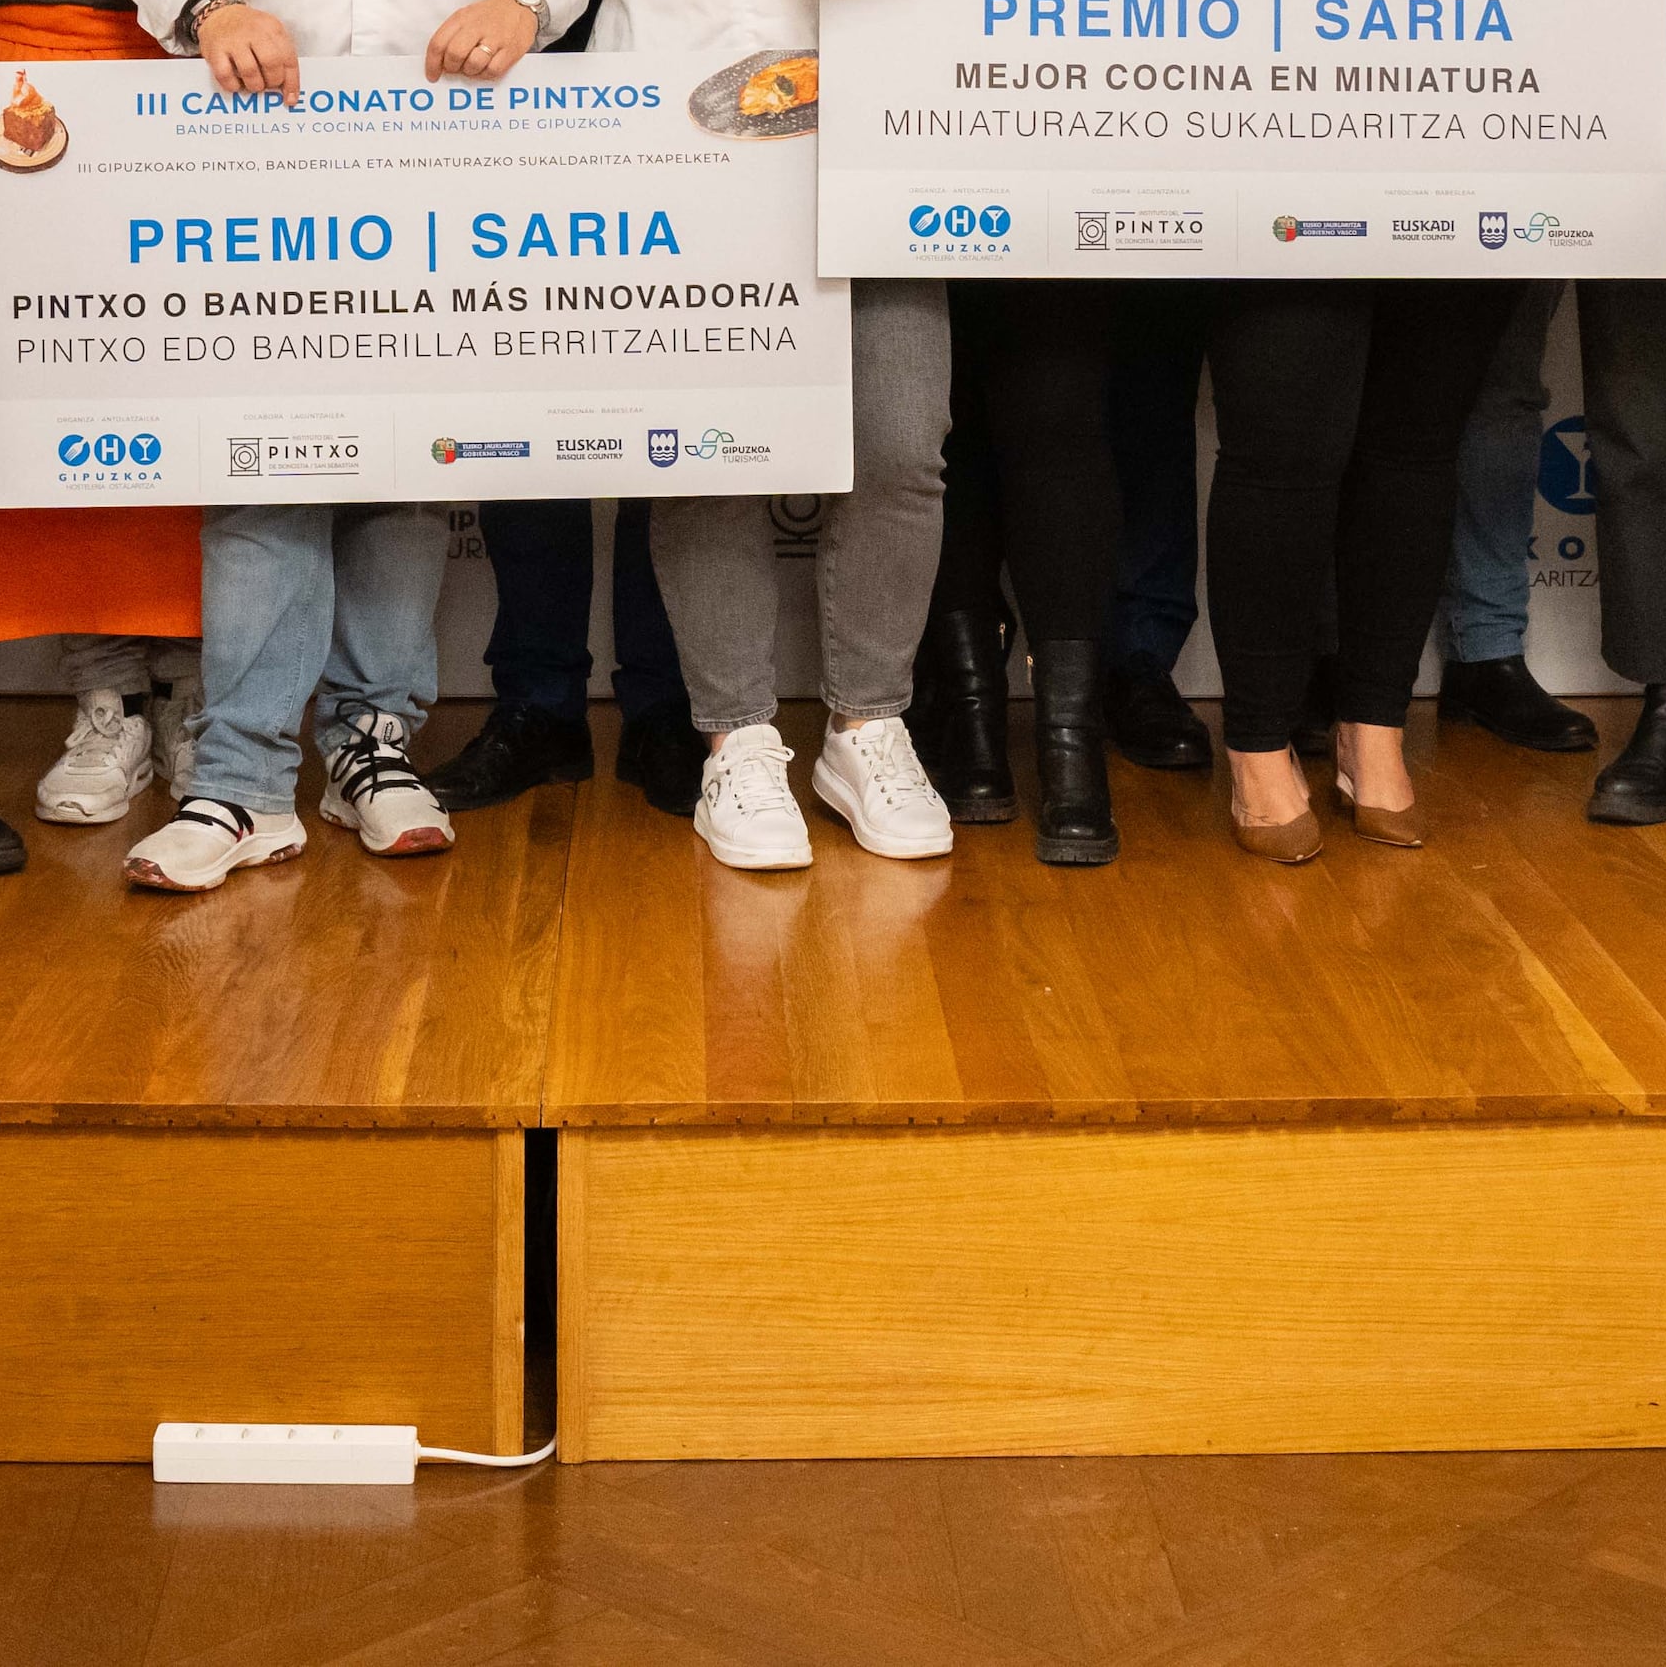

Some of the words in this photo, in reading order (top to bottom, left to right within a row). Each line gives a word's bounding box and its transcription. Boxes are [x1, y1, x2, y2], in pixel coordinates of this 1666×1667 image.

[956, 63, 1086, 89] MEJOR
[1106, 64, 1252, 90] COCINA
[1271, 66, 1316, 91] EN
[1336, 66, 1540, 93] MINIATURA
[137, 93, 166, 115] III
[181, 88, 433, 115] CAMPEONATO
[449, 86, 499, 110] DE
[509, 85, 660, 109] PINTXOS
[176, 122, 290, 135] BANDERILLAS
[296, 122, 305, 133] Y
[312, 121, 375, 133] COCINA
[382, 121, 403, 132] EN
[410, 119, 502, 131] MINIATURA
[509, 119, 529, 129] DE
[537, 117, 621, 129] GIPUZKOA
[885, 109, 1168, 138] MINIATURAZKO
[1186, 111, 1465, 139] SUKALDARITZA
[1483, 113, 1607, 139] ONENA
[78, 163, 91, 173] III
[97, 161, 196, 172] GIPUZKOAKO
[202, 160, 259, 171] PINTXO,
[266, 159, 361, 170] BANDERILLA
[367, 158, 393, 168] ETA
[399, 156, 513, 167] MINIATURAZKO
[518, 154, 631, 166] SUKALDARITZA
[637, 153, 730, 164] TXAPELKETA
[1115, 220, 1202, 233] PINTXO
[1392, 220, 1454, 231] EUSKADI
[130, 215, 392, 263] PREMIO
[472, 211, 680, 258] SARIA
[1548, 238, 1592, 247] TURISMOA
[909, 244, 1010, 252] GIPUZKOA
[13, 293, 145, 319] PINTXO
[163, 292, 186, 317] O
[205, 289, 434, 316] BANDERILLA
[452, 281, 527, 312] MÁS
[545, 282, 799, 310] INNOVADOR/A
[18, 337, 145, 363] PINTXO
[164, 335, 235, 361] EDO
[253, 332, 476, 360] BANDERILLA
[494, 326, 796, 356] BERRITZAILEENA
[269, 444, 358, 459] PINTXO
[556, 438, 622, 451] EUSKADI
[722, 445, 770, 454] GIPUZKOA
[722, 454, 769, 463] TURISMOA
[58, 472, 161, 481] GIPUZKOA
